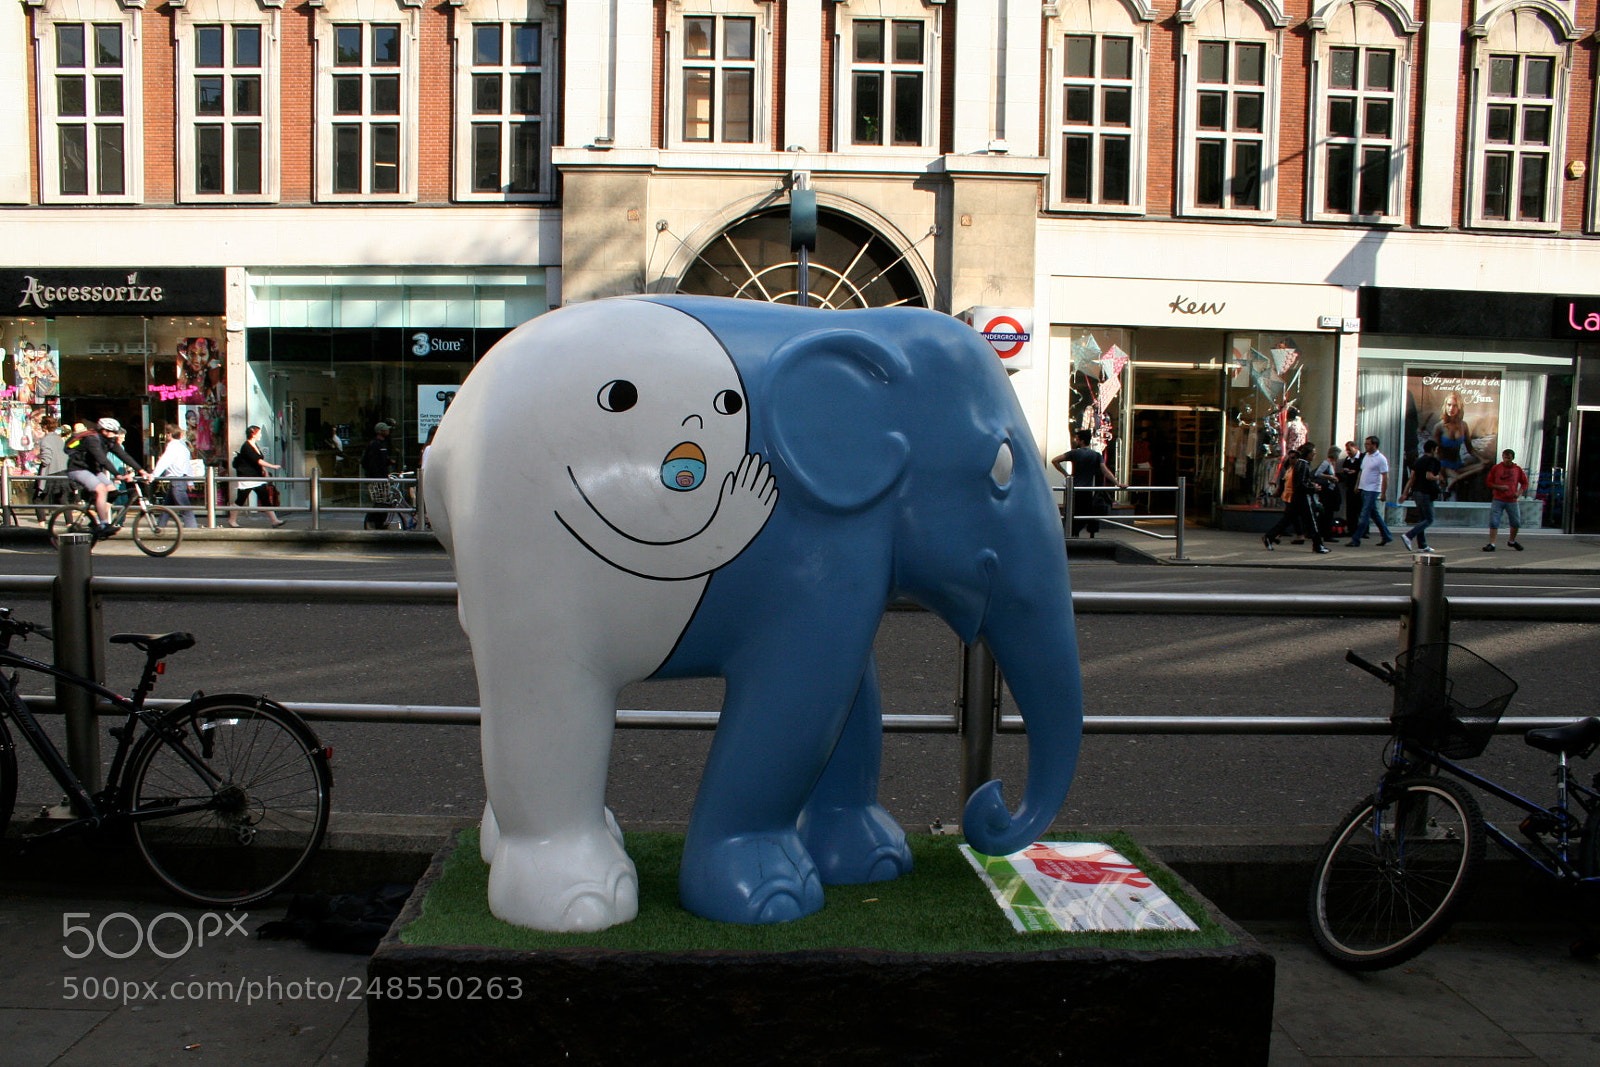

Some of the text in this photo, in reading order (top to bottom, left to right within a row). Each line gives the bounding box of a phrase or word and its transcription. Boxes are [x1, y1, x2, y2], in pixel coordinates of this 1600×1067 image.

[18, 272, 163, 309] Accessorize
[1168, 295, 1226, 315] Kew
[412, 332, 430, 356] 3
[982, 333, 1029, 341] NDERGROUND
